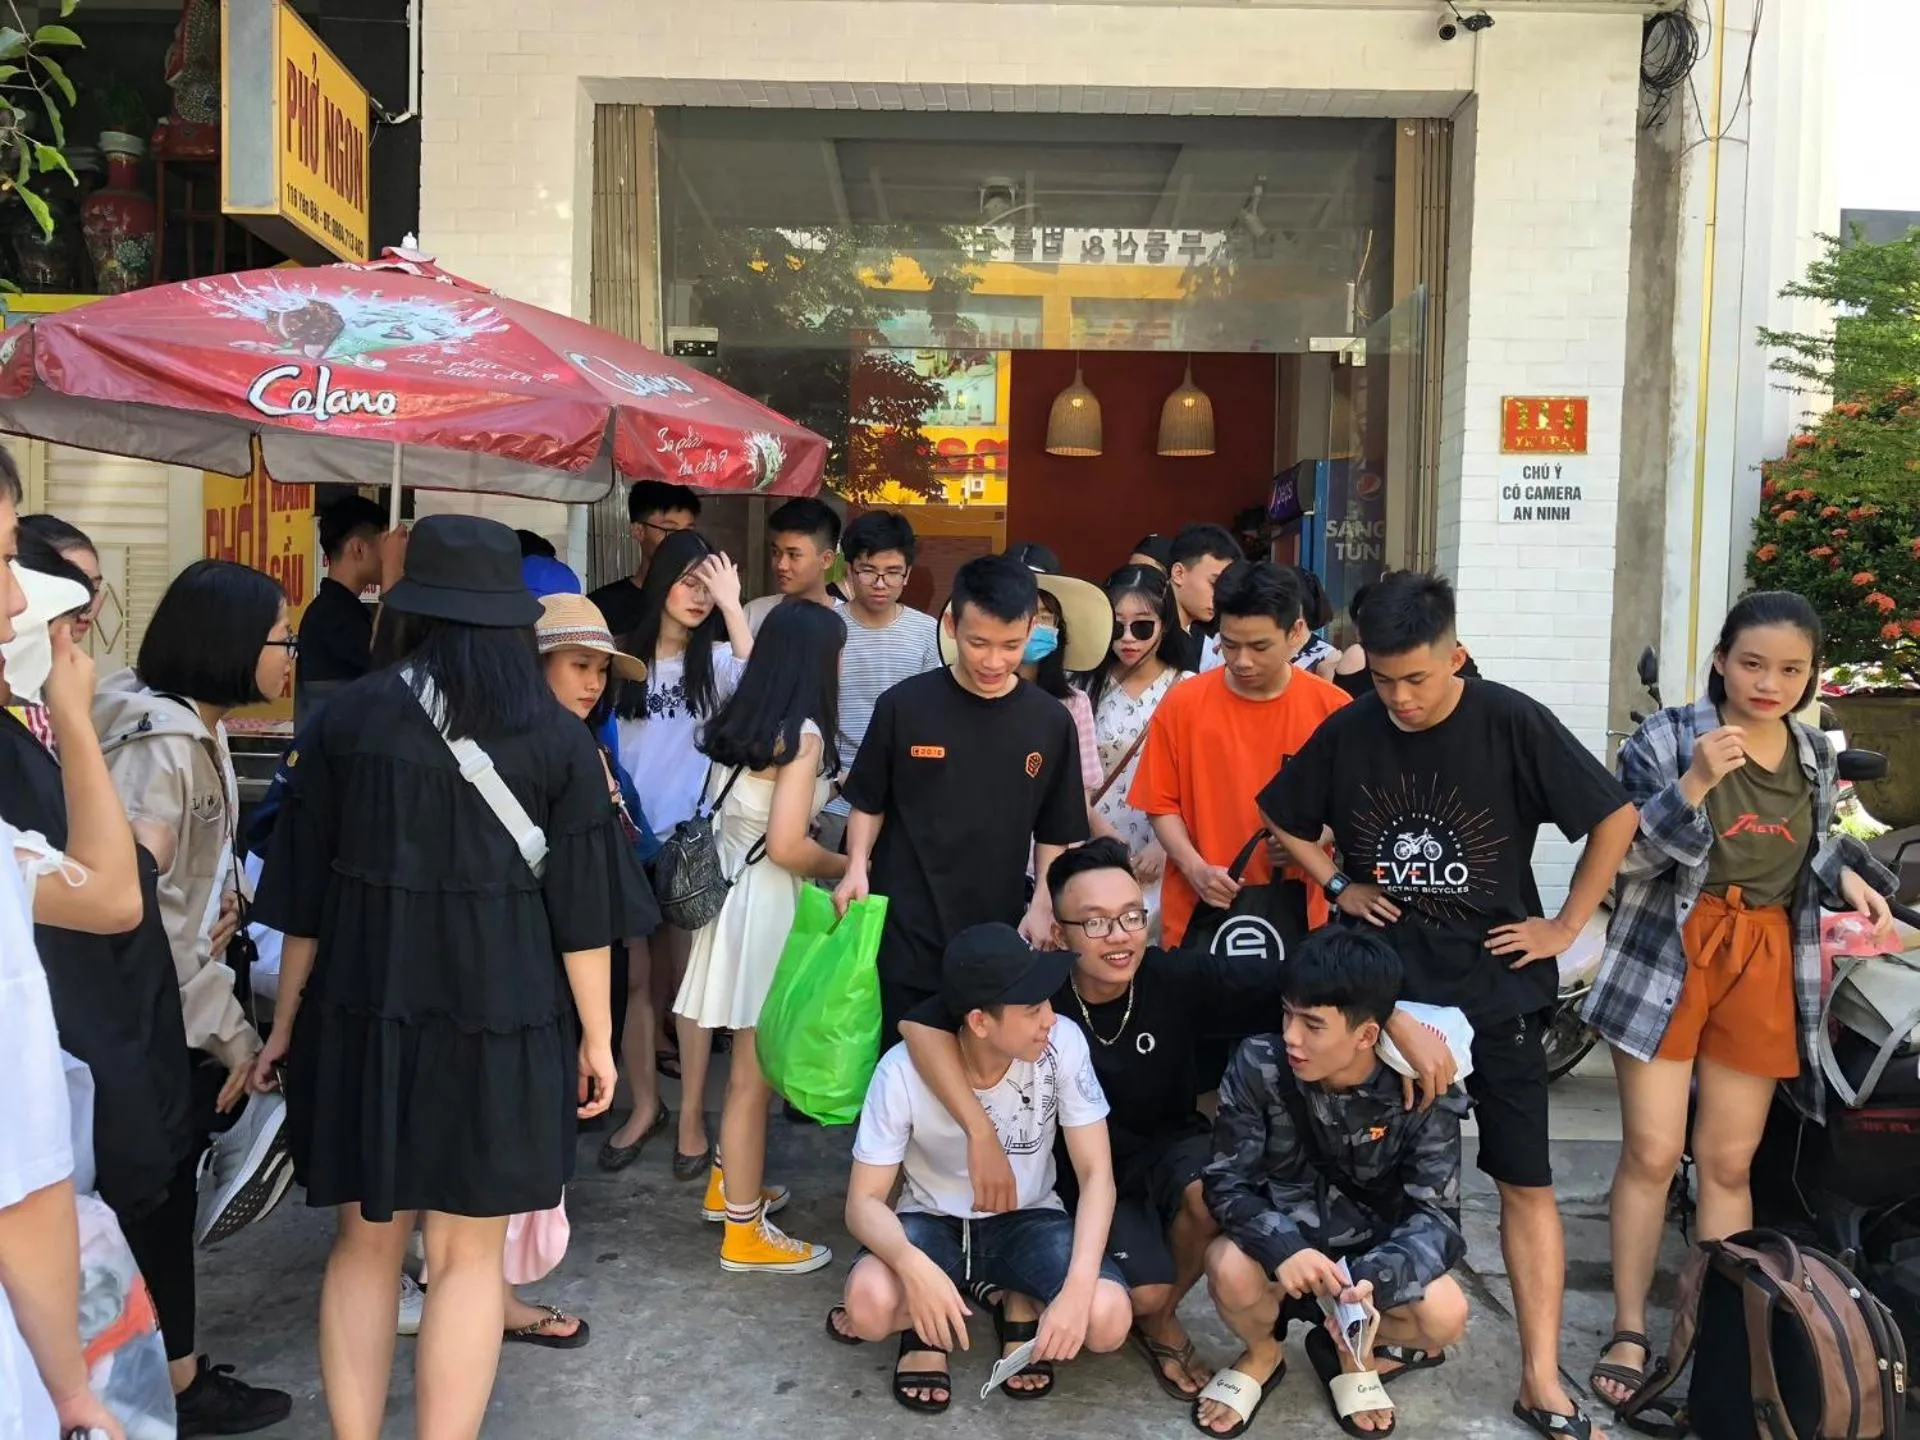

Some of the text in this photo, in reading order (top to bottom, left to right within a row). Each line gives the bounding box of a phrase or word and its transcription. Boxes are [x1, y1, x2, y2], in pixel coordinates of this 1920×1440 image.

[286, 51, 363, 214] PHỞ NGON
[247, 364, 398, 421] Celano
[1522, 462, 1562, 480] CHÚ Ý
[1525, 486, 1582, 500] CAMERA
[1513, 506, 1571, 521] AN NINH
[1372, 862, 1468, 886] EVELO
